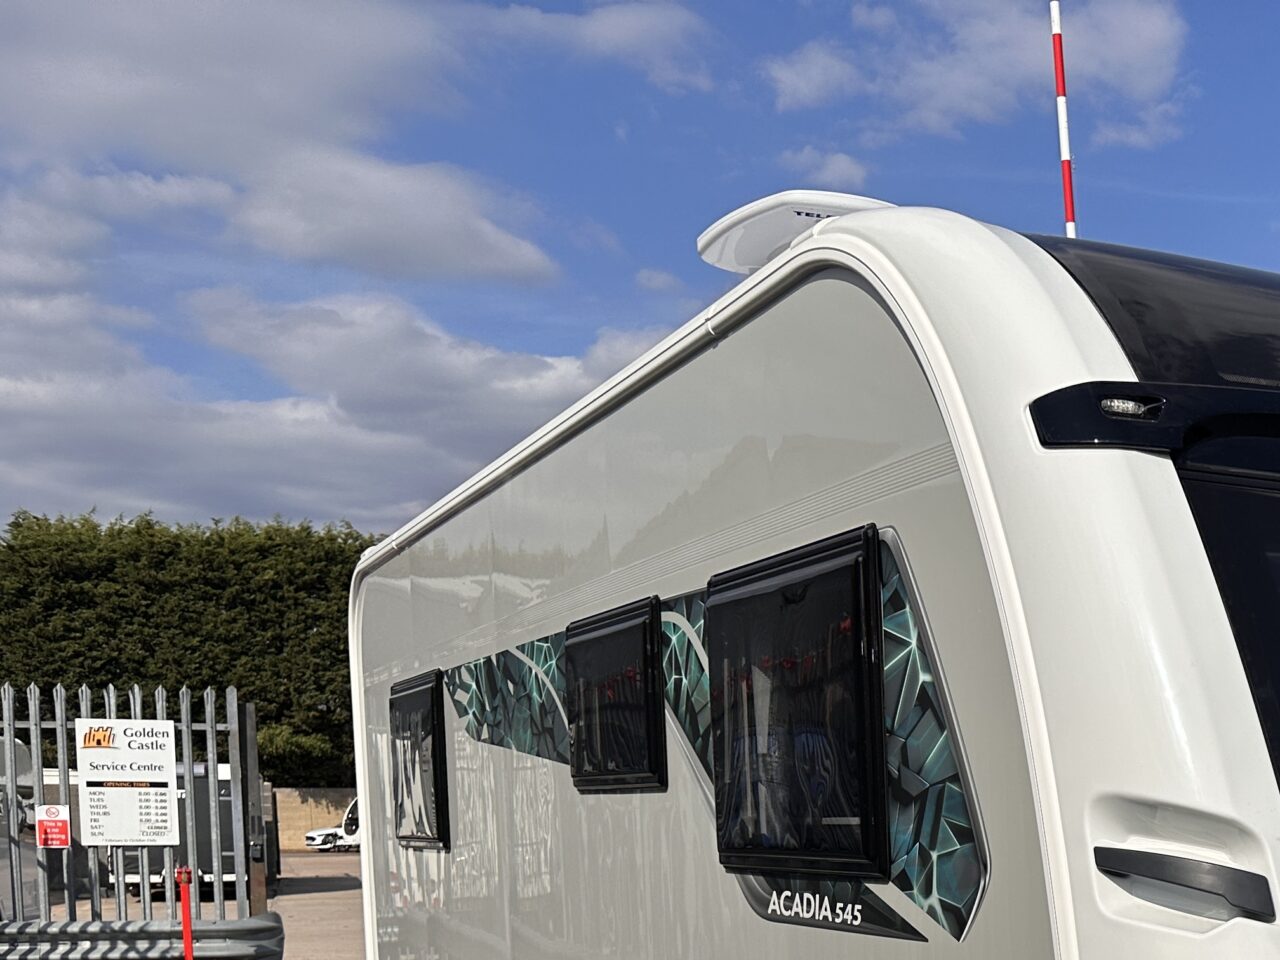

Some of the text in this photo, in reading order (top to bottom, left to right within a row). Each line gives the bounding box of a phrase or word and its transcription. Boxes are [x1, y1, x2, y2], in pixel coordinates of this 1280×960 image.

[123, 727, 169, 738] Golden
[127, 739, 166, 750] Castle
[89, 761, 164, 771] Service Centre
[768, 890, 862, 925] ACADIA 545
